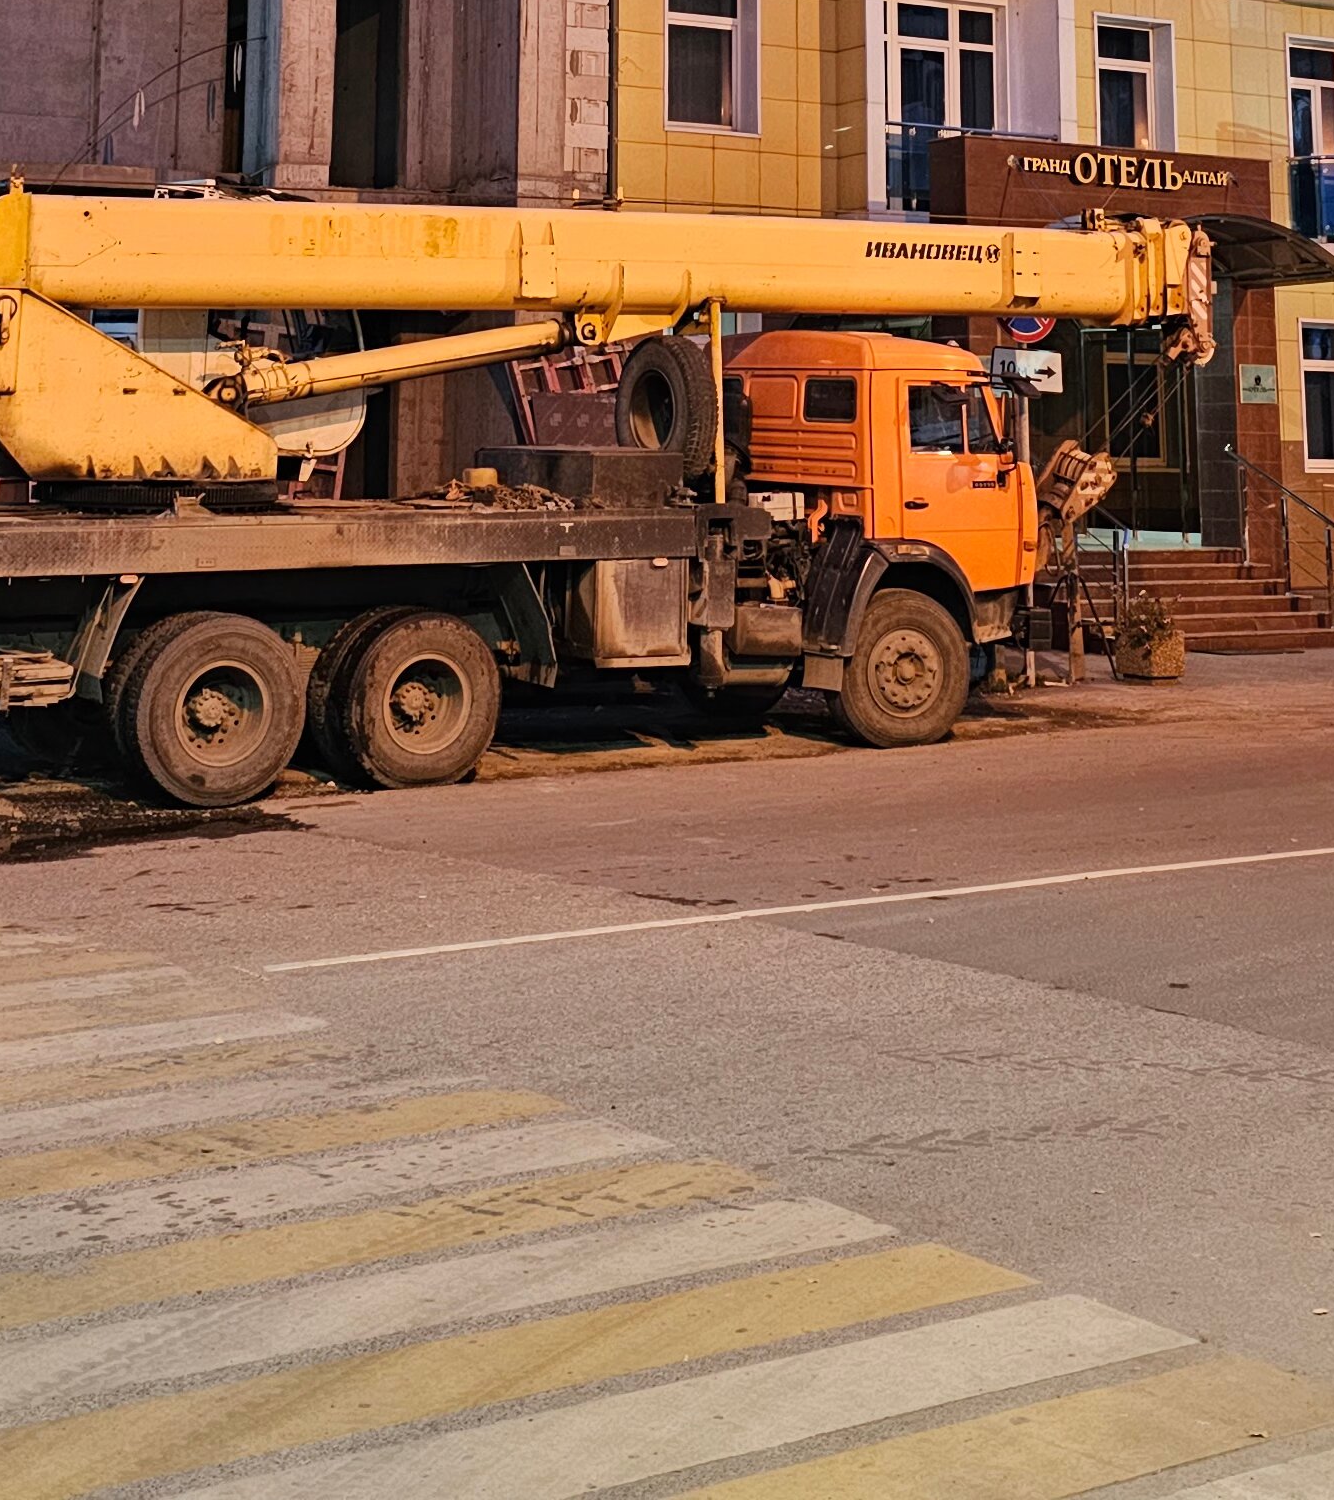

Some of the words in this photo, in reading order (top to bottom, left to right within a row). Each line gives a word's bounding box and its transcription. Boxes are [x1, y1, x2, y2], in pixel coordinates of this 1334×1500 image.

[1023, 156, 1071, 175] ГРАНД
[1074, 152, 1183, 191] ОТЕЛЬ
[1182, 169, 1228, 186] АЛТАЙ
[865, 241, 983, 264] ИВАНОВЕЦ
